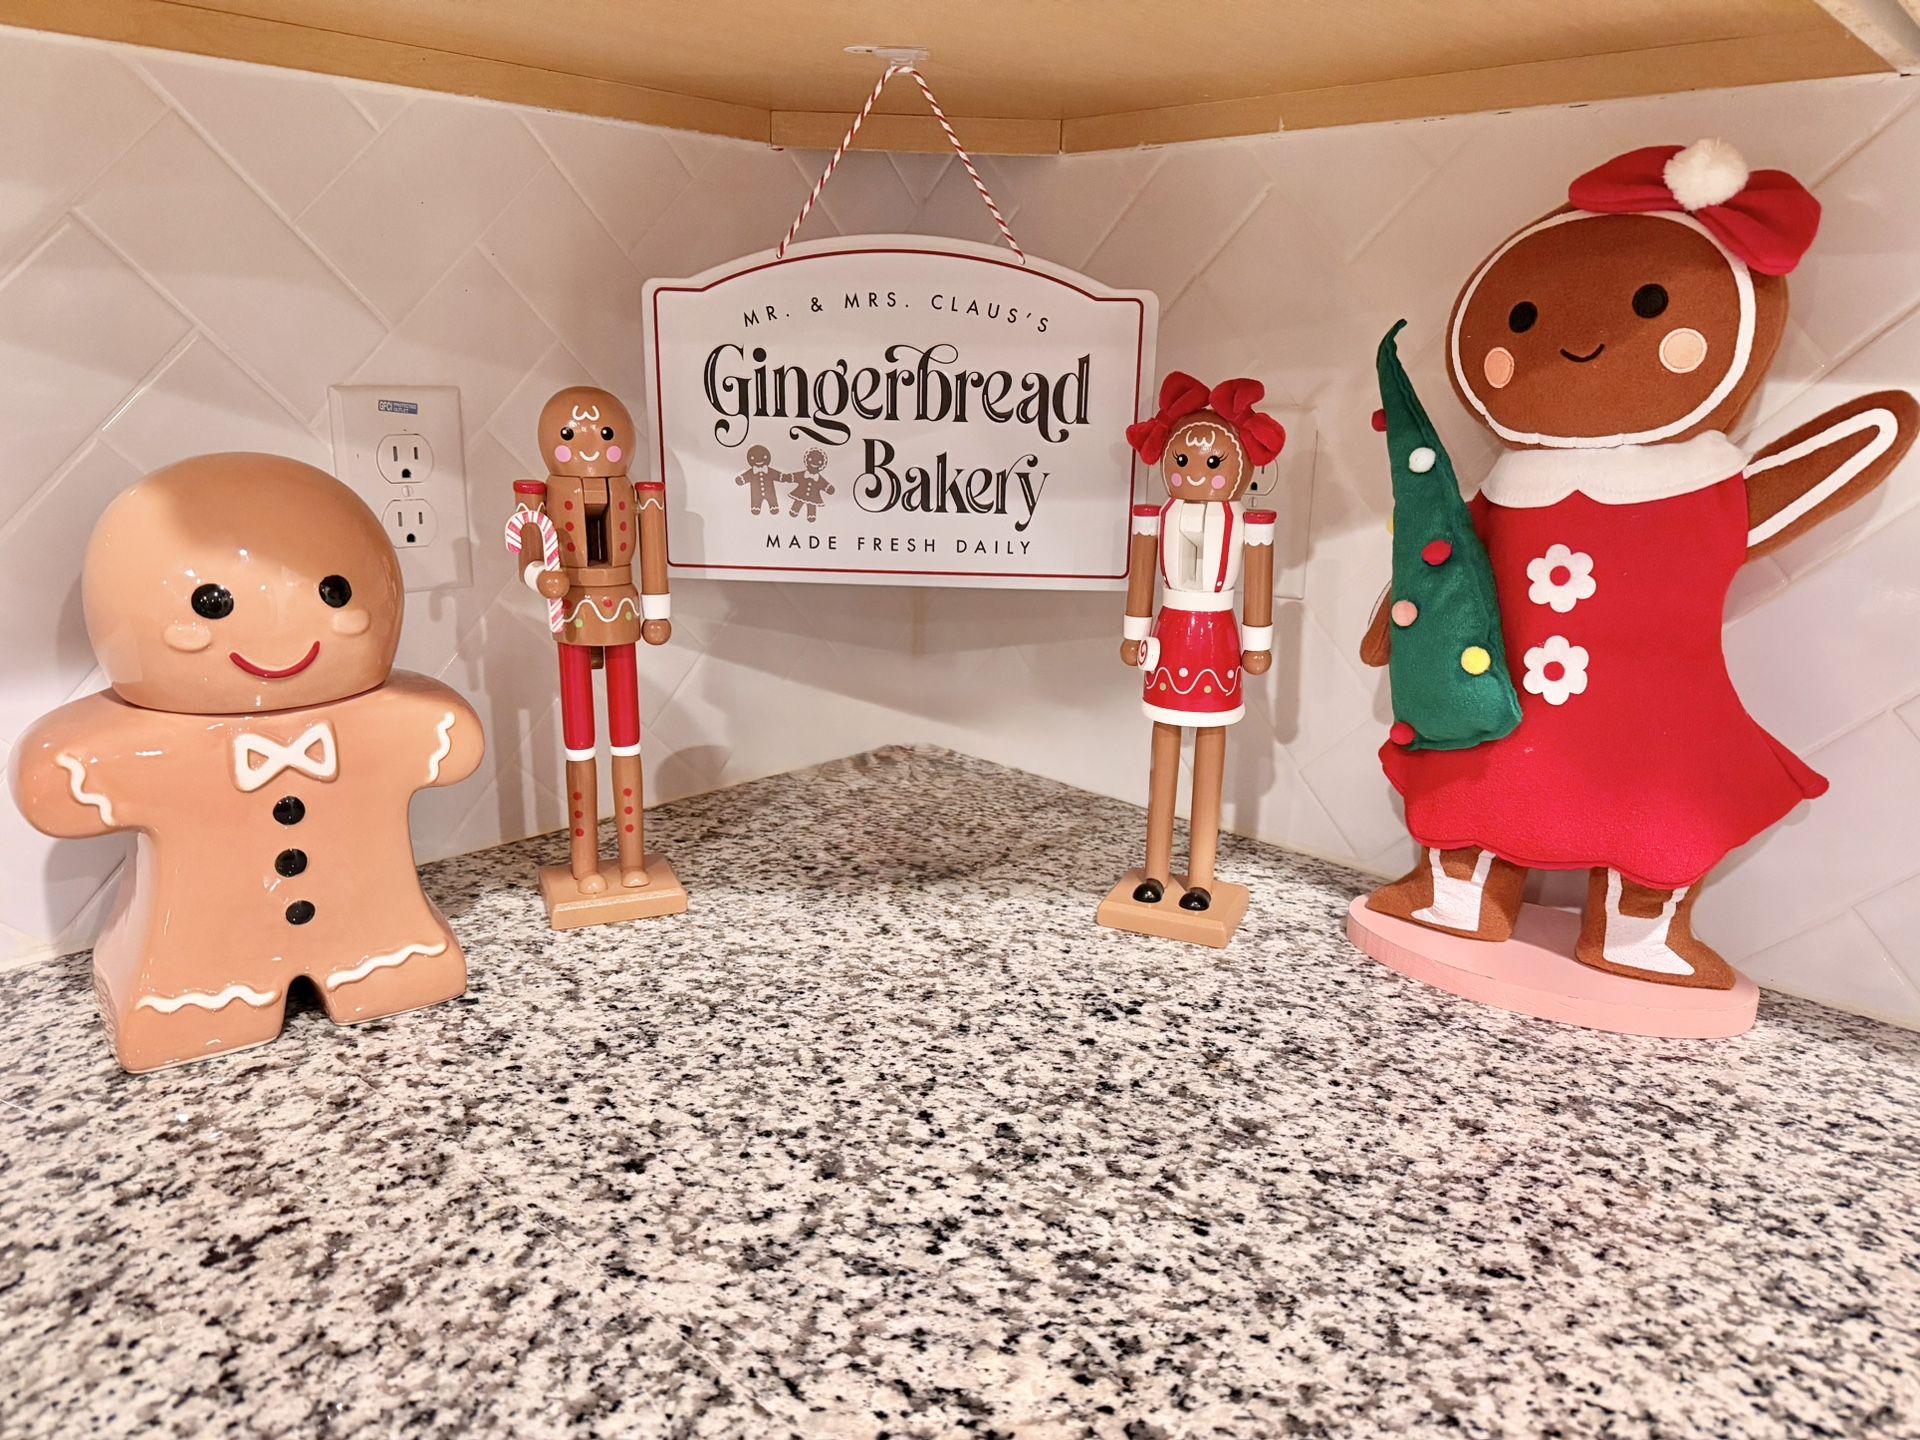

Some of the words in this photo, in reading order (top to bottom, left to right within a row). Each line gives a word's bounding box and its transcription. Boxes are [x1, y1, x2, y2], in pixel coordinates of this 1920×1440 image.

[744, 305, 790, 328] MR.
[810, 297, 823, 313] &
[844, 291, 910, 309] MRS.
[930, 294, 1049, 333] CLAUS'S
[703, 343, 1091, 448] Gingerbread
[853, 438, 1051, 532] Bakery
[766, 534, 838, 550] MADE
[857, 537, 936, 553] FRESH
[956, 539, 1031, 555] DAILY
